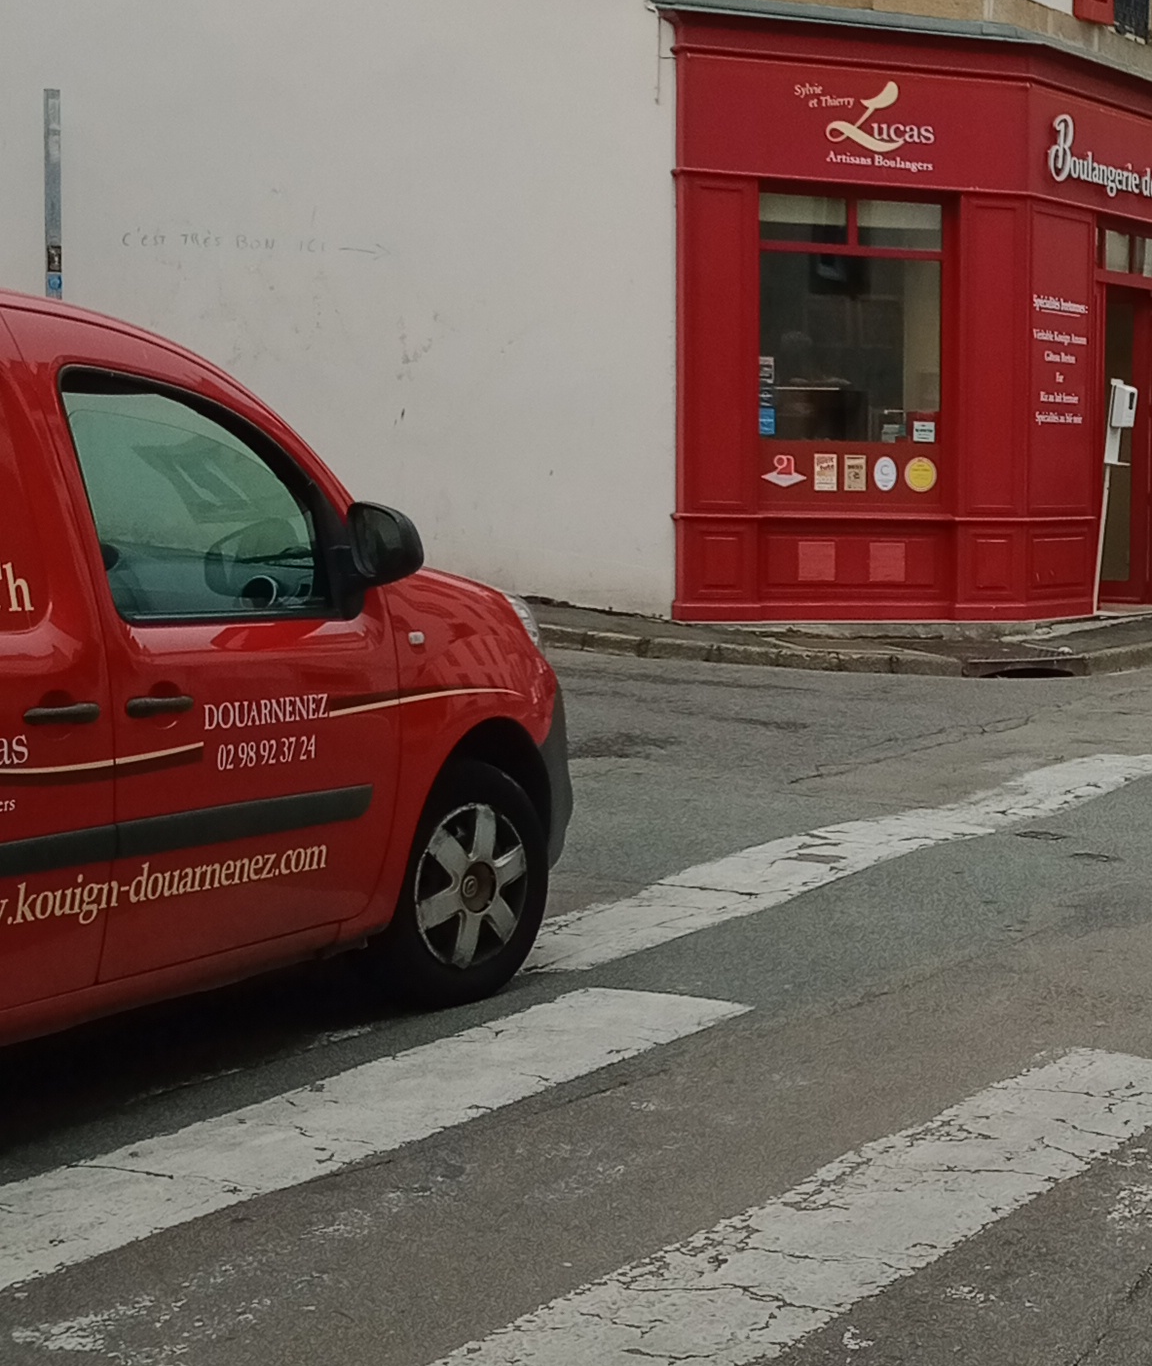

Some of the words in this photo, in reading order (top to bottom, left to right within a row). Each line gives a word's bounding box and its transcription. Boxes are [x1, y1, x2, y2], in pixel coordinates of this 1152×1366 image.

[794, 83, 823, 98] Sylvie
[808, 99, 818, 108] et
[820, 95, 854, 109] Thierry
[826, 81, 935, 153] Lucas
[826, 150, 872, 166] Artisans
[874, 154, 933, 173] Boulangers
[1048, 114, 1140, 197] Boulangerie
[236, 235, 275, 250] BON
[204, 693, 328, 730] DOUARNENEZ
[217, 744, 234, 771] 02
[238, 741, 256, 768] 98
[260, 739, 276, 765] 92
[280, 737, 296, 762] 37
[299, 734, 316, 761] 24
